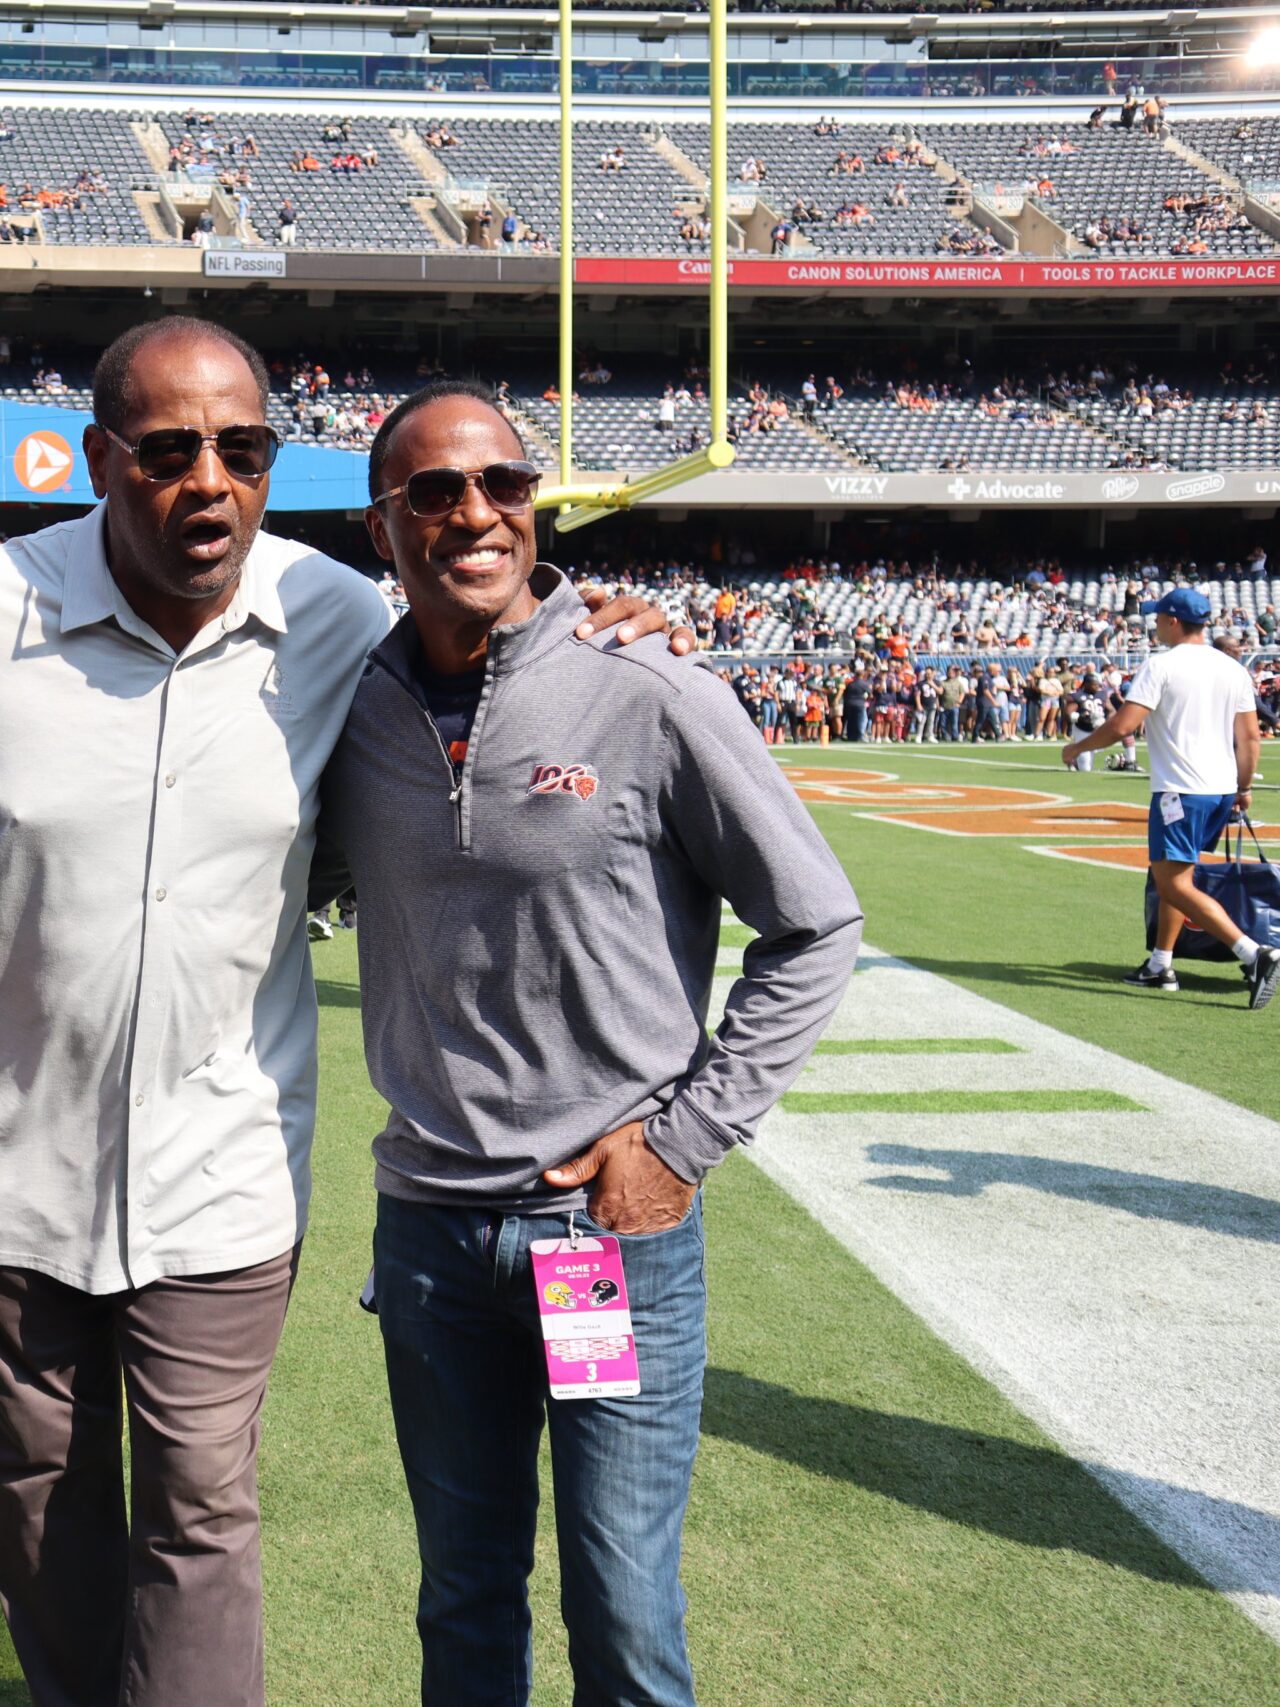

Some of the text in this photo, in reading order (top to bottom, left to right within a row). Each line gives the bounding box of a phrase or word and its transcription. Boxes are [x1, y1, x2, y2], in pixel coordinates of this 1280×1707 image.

[208, 257, 283, 274] NFL Passing
[788, 266, 1003, 281] CANON SOLUTIONS AMERICA
[1042, 265, 1276, 281] TOOLS TO TACKLE WORKPLACE
[824, 477, 889, 494] VIZZY
[975, 480, 1064, 499] Advocate
[1170, 477, 1222, 498] snapple
[555, 1263, 601, 1275] GAME 3
[586, 1362, 598, 1382] 3
